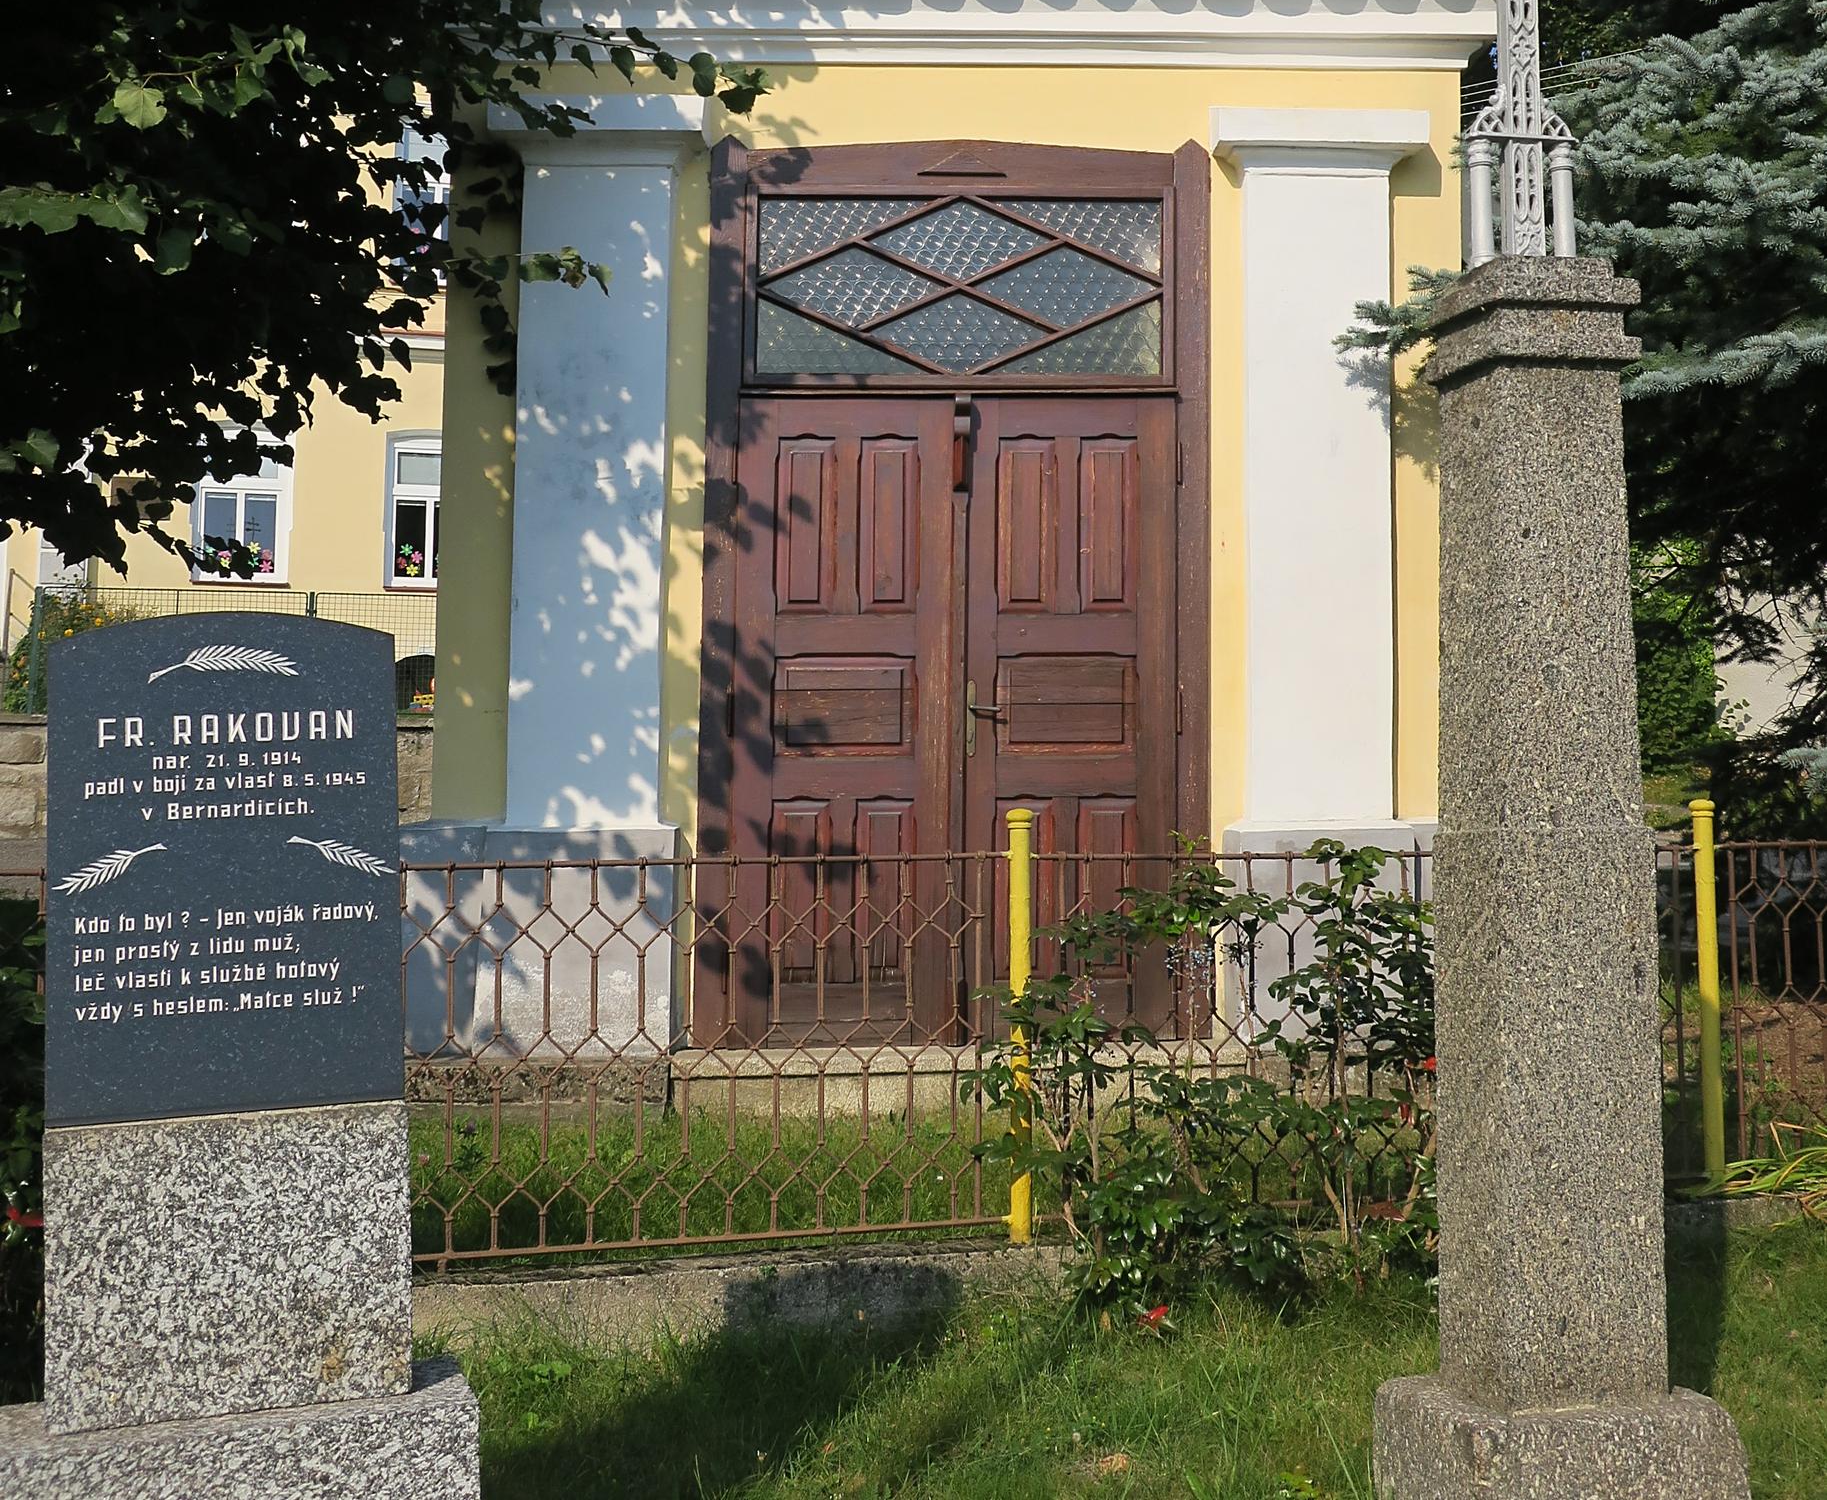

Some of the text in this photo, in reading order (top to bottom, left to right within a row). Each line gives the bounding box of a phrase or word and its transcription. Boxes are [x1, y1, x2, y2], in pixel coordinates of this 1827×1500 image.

[97, 710, 354, 748] FR. RAKOVAN
[152, 754, 191, 770] nar.
[263, 751, 301, 765] 1914
[84, 777, 124, 800] padl
[133, 780, 143, 793] v
[153, 774, 186, 795] boji
[195, 777, 215, 791] za
[325, 772, 366, 786] 1945
[141, 798, 315, 821] v Bernardicích.
[74, 916, 110, 935] Kdo
[119, 914, 135, 932] to
[144, 912, 172, 933] byl
[216, 908, 245, 929] Jen
[254, 905, 304, 927] voják
[73, 934, 300, 967] jen prostý z lidu muž;
[75, 958, 340, 992] leč vlasti k službě hotový
[75, 1002, 122, 1024] vždy
[133, 1004, 143, 1017] s
[153, 996, 229, 1016] heslem:
[303, 987, 342, 1006] služ
